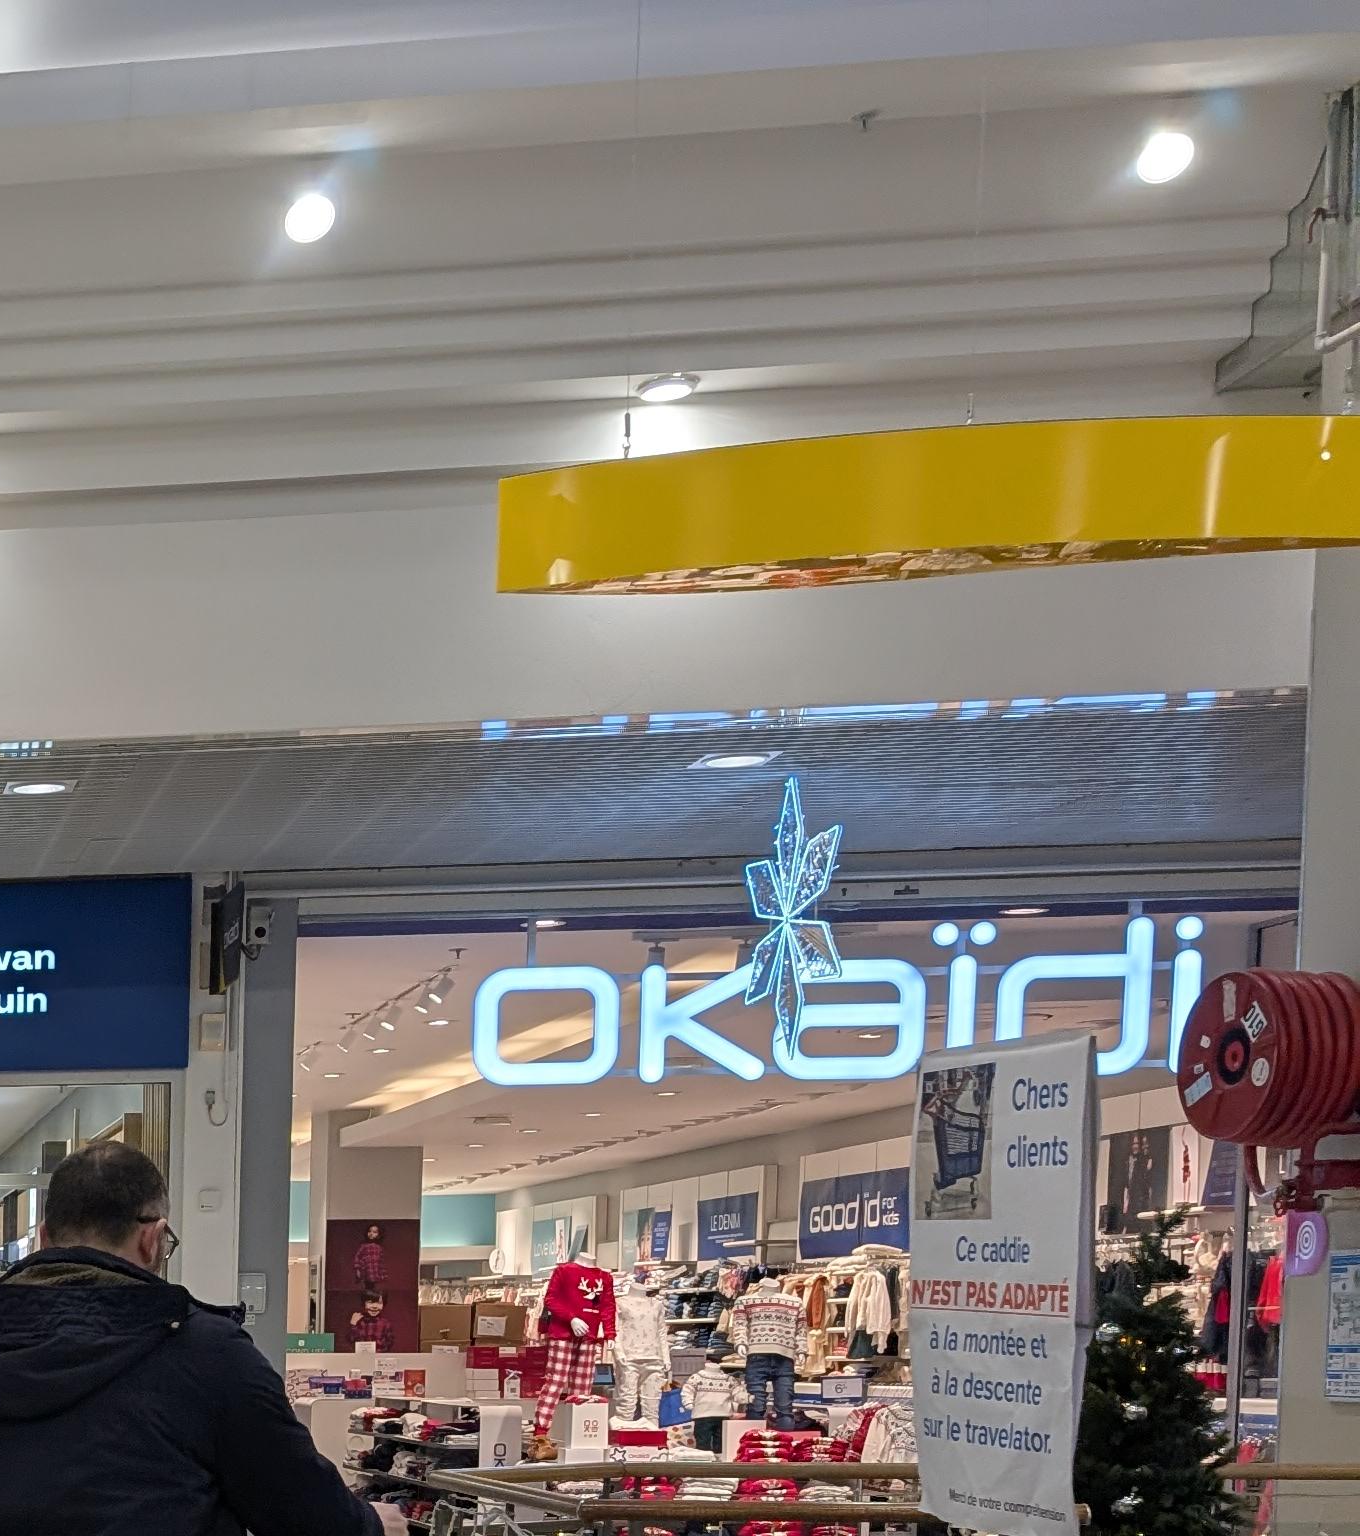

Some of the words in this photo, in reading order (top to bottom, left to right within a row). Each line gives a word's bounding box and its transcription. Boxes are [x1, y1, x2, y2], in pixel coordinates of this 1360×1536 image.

[1011, 1078, 1070, 1112] Chers
[1006, 1135, 1070, 1169] clients
[710, 1214, 718, 1232] LE
[718, 1212, 741, 1229] DENIM
[955, 1236, 977, 1263] Ce
[981, 1237, 1031, 1264] caddie
[911, 1279, 962, 1307] N'EST
[965, 1282, 997, 1308] PAS
[1000, 1278, 1070, 1314] ADAPTÉ
[929, 1325, 939, 1351] à
[942, 1325, 957, 1351] la
[963, 1328, 1026, 1358] montée
[1030, 1334, 1048, 1359] et
[931, 1369, 940, 1396] à
[943, 1369, 958, 1397] la
[963, 1372, 1042, 1406] descente
[923, 1419, 942, 1439] sur
[946, 1415, 961, 1442] le
[965, 1416, 1053, 1455] travelator.
[949, 1488, 966, 1504] Merci
[967, 1492, 977, 1506] de
[979, 1498, 1002, 1511] votre
